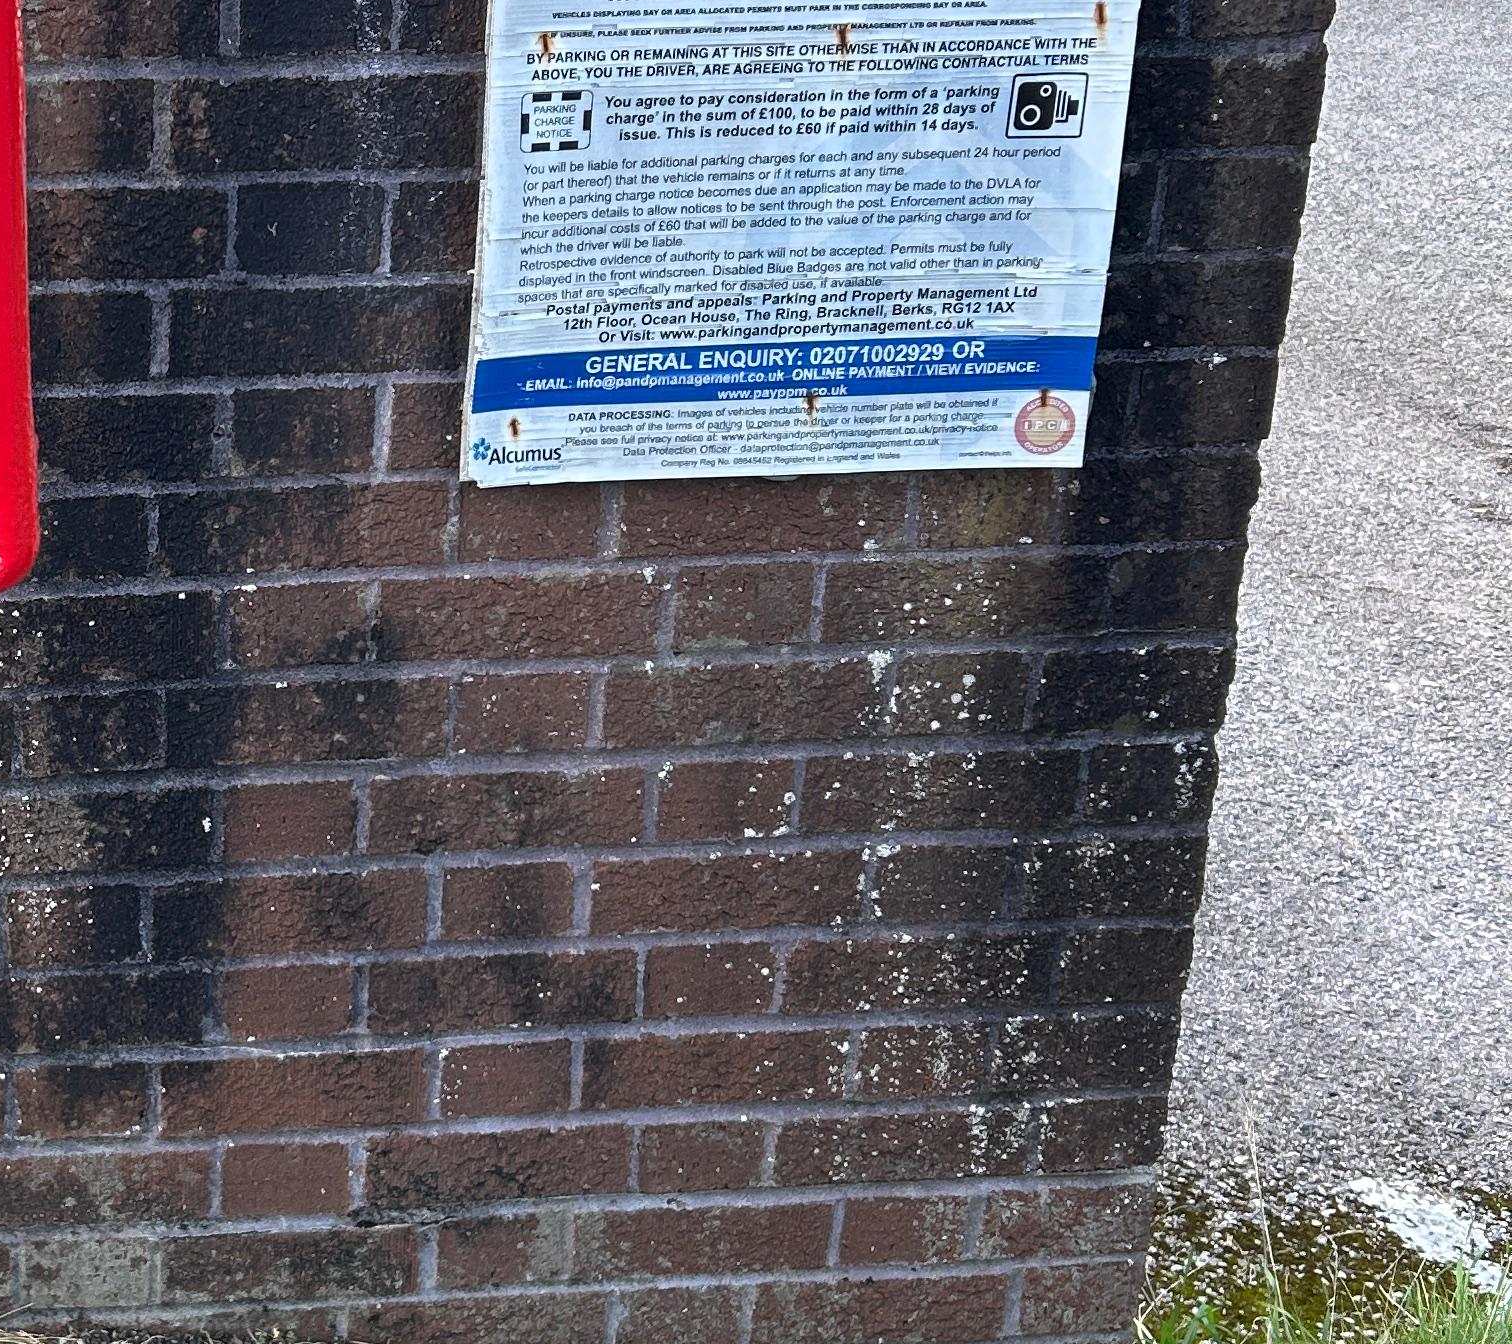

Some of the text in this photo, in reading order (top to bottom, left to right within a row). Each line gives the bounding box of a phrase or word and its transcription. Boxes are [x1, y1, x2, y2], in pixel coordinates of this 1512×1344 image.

[527, 53, 544, 65] BY
[547, 50, 606, 64] PARKING
[611, 50, 629, 62] OR
[634, 47, 709, 61] REMAINING
[713, 47, 729, 59] AT
[732, 46, 762, 58] THIS
[766, 45, 795, 57] SITE
[882, 42, 919, 54] THAN
[923, 42, 935, 53] IN
[938, 39, 1031, 52] ACCORDANCE
[1034, 38, 1068, 50] WITH
[1072, 38, 1097, 48] THE
[534, 104, 576, 114] PARKING
[534, 116, 575, 126] CHARGE
[537, 129, 572, 138] NOTICE
[546, 304, 589, 316] Postal
[595, 300, 662, 315] payments
[666, 298, 693, 310] and
[762, 292, 816, 306] Parking
[821, 291, 848, 303] and
[852, 289, 912, 302] Property
[918, 287, 1009, 300] Management
[1014, 286, 1038, 298] Ltd
[564, 301, 1015, 330] 12th Floor, Ocean House, The Ring, Bracknell, Berks, RG12 1AX
[599, 318, 974, 343] Or Visit: www.parkingandpropertymanagement.co.uk
[586, 341, 984, 373] GENERAL ENQUIRY: 02071002929 OR
[525, 378, 572, 392] EMAIL:
[576, 369, 784, 390] info@pandpmanagement.co.uk
[792, 368, 844, 380] ONLINE
[848, 365, 915, 379] PAYMENT
[926, 364, 962, 376] VIEW
[964, 361, 1040, 375] EVIDENCE:
[488, 447, 562, 466] Alcumus
